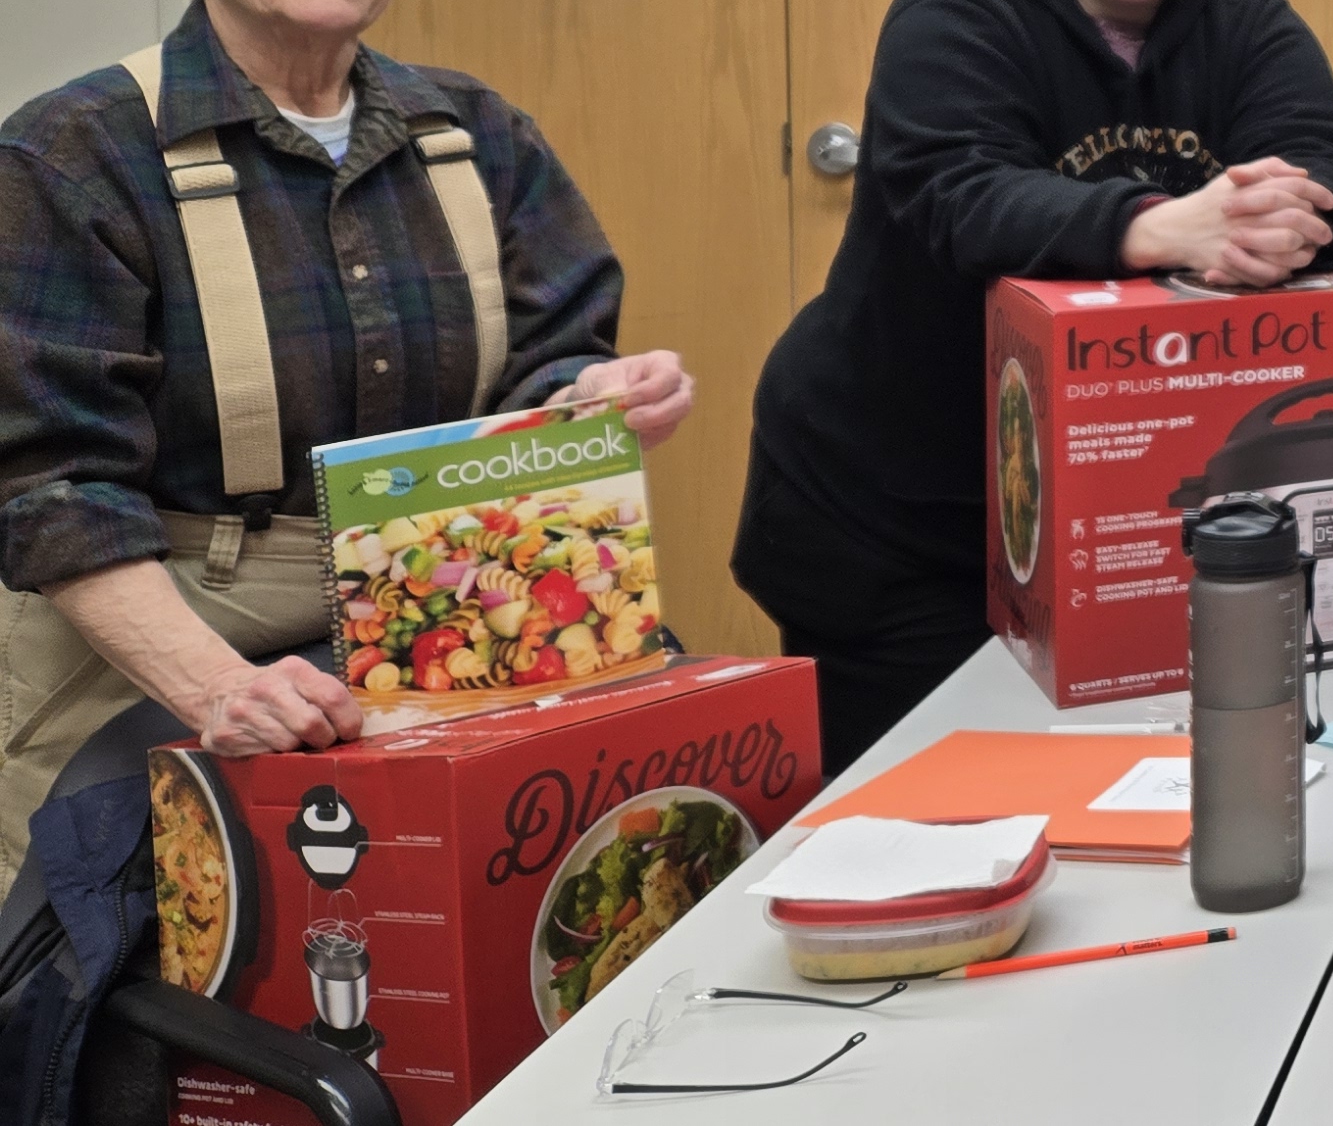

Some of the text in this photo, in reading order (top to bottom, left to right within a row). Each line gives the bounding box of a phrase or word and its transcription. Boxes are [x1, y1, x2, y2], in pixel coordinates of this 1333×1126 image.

[1067, 318, 1238, 371] Instant
[1252, 310, 1328, 356] Pot
[1118, 378, 1164, 395] PLUS
[1168, 365, 1306, 391] MULTI-COOKER
[1068, 415, 1195, 436] Delicious one-pot
[1068, 432, 1153, 450] meals made
[437, 424, 630, 489] cookbook
[1068, 450, 1099, 464] 70%
[486, 719, 799, 888] Discover
[177, 1077, 255, 1095] Dishwasher-safe
